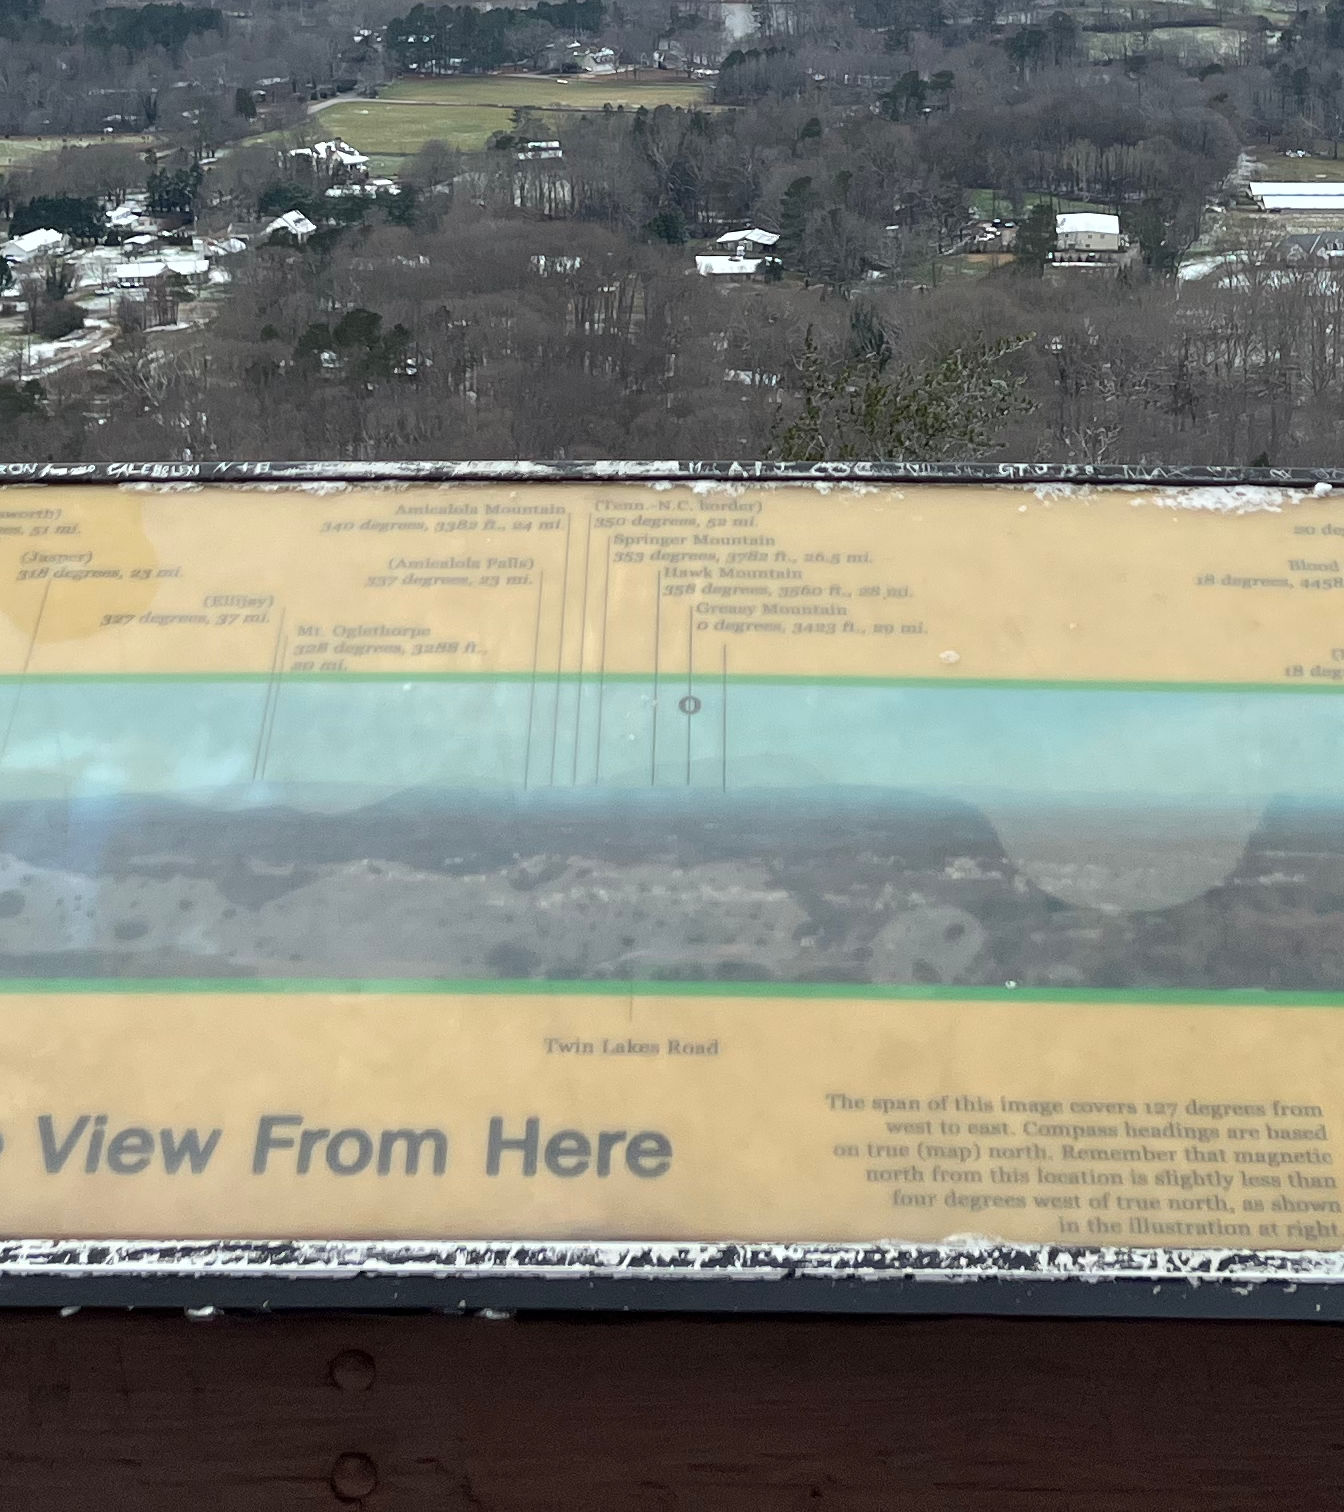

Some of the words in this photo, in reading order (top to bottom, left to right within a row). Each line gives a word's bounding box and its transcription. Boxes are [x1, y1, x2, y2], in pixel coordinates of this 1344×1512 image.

[480, 504, 566, 516] Mountain
[359, 519, 429, 533] degrees,
[632, 515, 700, 529] degrees,
[613, 533, 687, 548] Springer
[693, 534, 776, 546] Mountain
[650, 550, 721, 565] degrees,
[53, 566, 124, 582] degrees,
[663, 567, 712, 579] Hawk
[719, 567, 803, 580] Mountain
[701, 583, 773, 598] degrees,
[761, 603, 848, 616] Mountain
[139, 612, 210, 627] degrees,
[714, 619, 787, 634] degrees,
[333, 625, 431, 640] Oglethorpe
[333, 642, 405, 657] degrees,
[545, 1038, 594, 1055] Twin
[601, 1038, 660, 1055] Lakes
[667, 1038, 719, 1056] Road
[825, 1093, 865, 1112] The
[872, 1097, 921, 1115] span
[928, 1094, 949, 1112] of
[956, 1095, 994, 1113] this
[1001, 1096, 1064, 1117] image
[1070, 1100, 1137, 1116] covers
[1145, 1101, 1178, 1118] 127
[1185, 1099, 1266, 1120] degrees
[1272, 1099, 1323, 1118] from
[886, 1120, 933, 1136] west
[940, 1120, 960, 1136] to
[967, 1121, 1016, 1136] east.
[1022, 1120, 1119, 1141] Compass
[1124, 1120, 1220, 1142] headings
[1227, 1128, 1260, 1140] are
[1265, 1123, 1328, 1141] based
[37, 1113, 223, 1175] View
[252, 1114, 449, 1176] From
[485, 1115, 673, 1178] Here
[833, 1145, 859, 1159] on
[867, 1143, 910, 1159] true
[917, 1142, 982, 1162] (map)
[988, 1143, 1054, 1161] north.
[1061, 1144, 1177, 1163] Remember
[1184, 1147, 1226, 1164] that
[1233, 1148, 1333, 1167] magnetic
[866, 1164, 924, 1183] north
[932, 1164, 982, 1183] from
[990, 1166, 1029, 1184] this
[1037, 1167, 1123, 1186] location
[1130, 1168, 1147, 1186] is
[1154, 1168, 1234, 1191] slightly
[1241, 1170, 1281, 1188] less
[1288, 1170, 1337, 1189] than
[892, 1189, 937, 1208] four
[944, 1190, 1026, 1212] degrees
[1033, 1193, 1081, 1209] west
[1089, 1192, 1111, 1210] of
[1117, 1194, 1160, 1210] true
[1168, 1194, 1235, 1214] north,
[1243, 1198, 1264, 1212] as
[1271, 1194, 1341, 1214] shown
[1060, 1217, 1079, 1234] in
[1088, 1216, 1121, 1234] the
[1129, 1217, 1251, 1236] illustration
[1259, 1220, 1277, 1236] at
